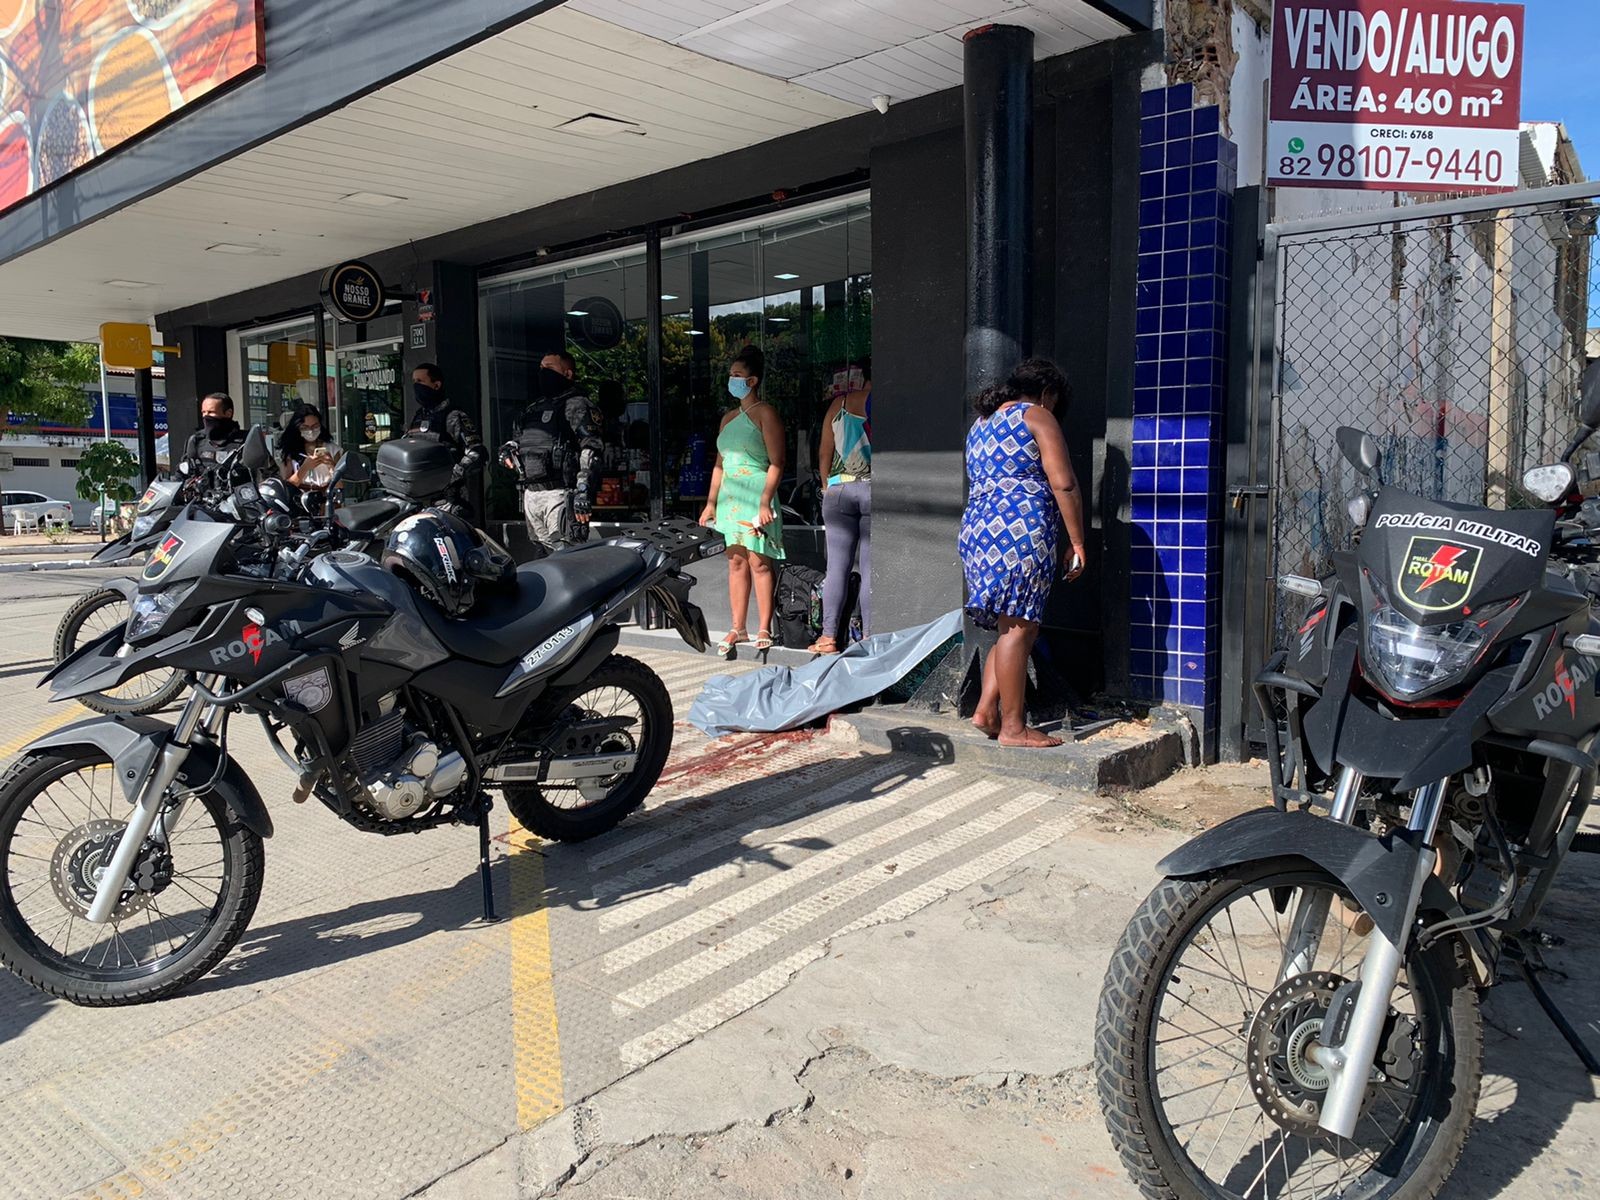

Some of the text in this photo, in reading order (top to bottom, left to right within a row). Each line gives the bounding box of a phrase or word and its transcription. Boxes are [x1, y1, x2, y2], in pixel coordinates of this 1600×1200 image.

[1284, 7, 1515, 79] VENDO/ALUGO
[1290, 77, 1387, 113] ÁREA:
[1394, 88, 1452, 115] 460
[1370, 128, 1434, 140] CRECI: 6768
[1279, 143, 1503, 183] 82 98107-9440
[342, 293, 372, 306] GRANEL
[344, 283, 370, 296] NOSSO
[353, 354, 381, 372] ESTAMOS
[353, 368, 396, 389] FUNCIONANDO
[1375, 512, 1541, 557] POLÍCIA MILITAR
[1407, 561, 1470, 585] ROTAM
[209, 619, 302, 665] ROCAM
[524, 625, 575, 668] 27-0113
[1532, 655, 1599, 720] ROCAM
